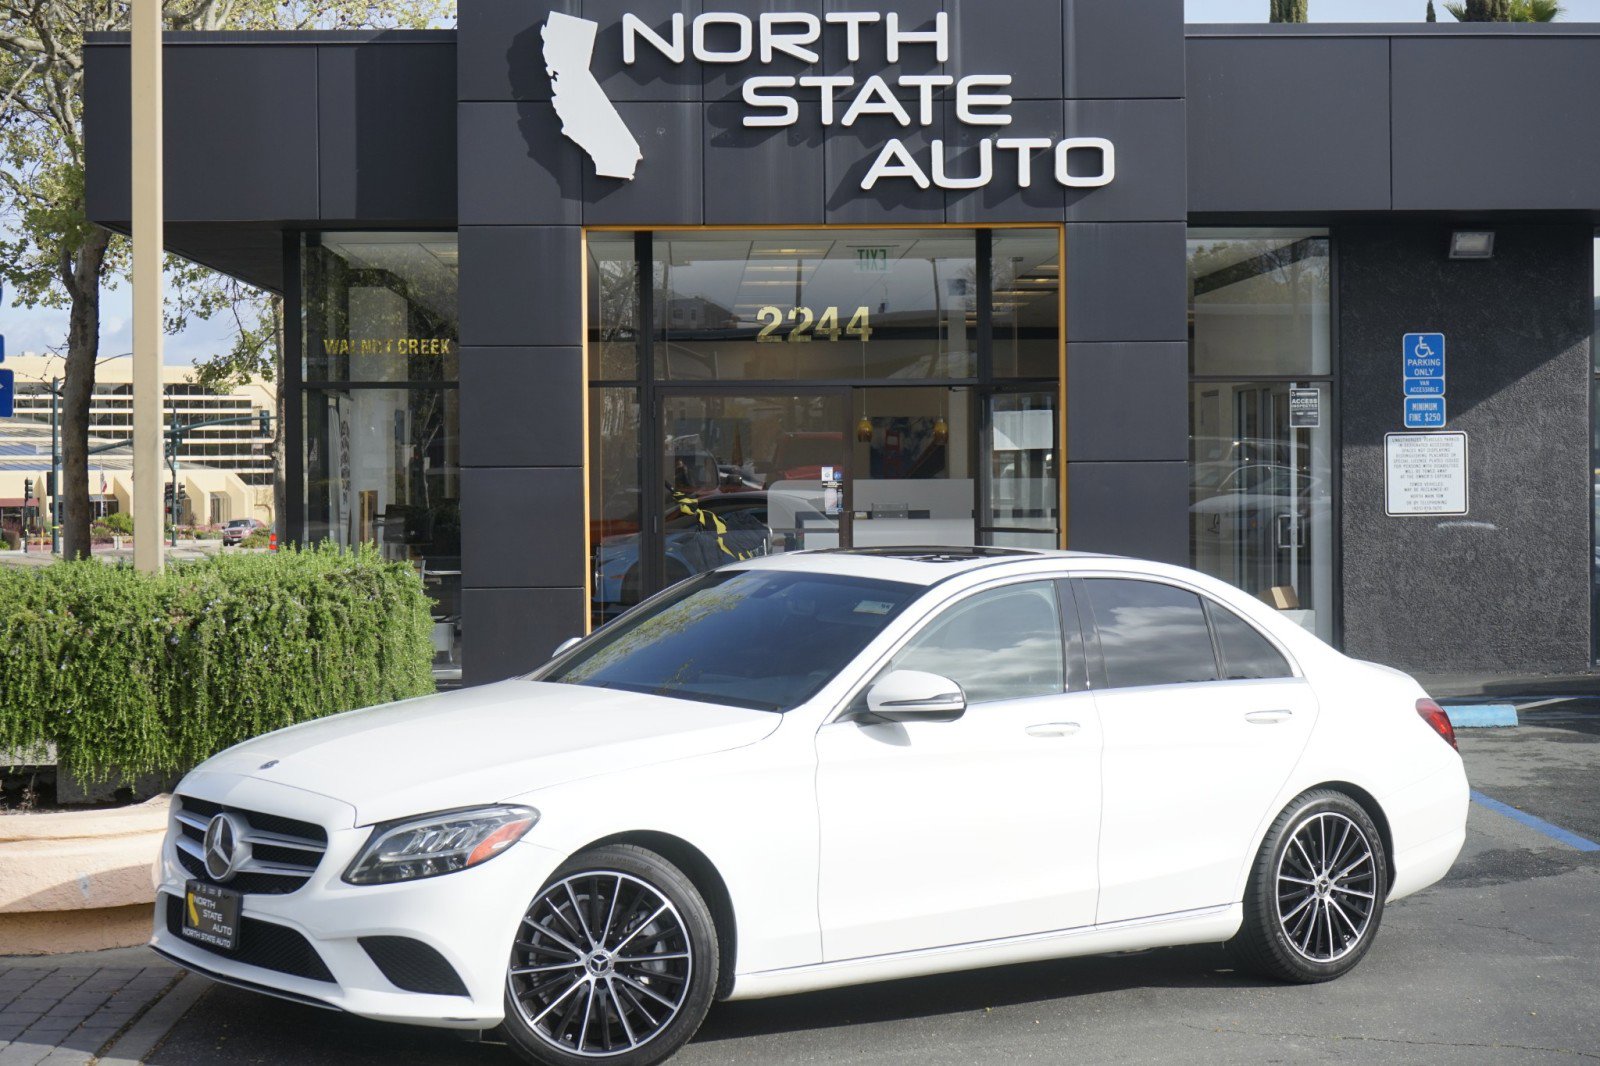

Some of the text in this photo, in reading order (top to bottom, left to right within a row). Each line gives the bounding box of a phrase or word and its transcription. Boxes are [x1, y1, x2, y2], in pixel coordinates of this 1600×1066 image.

[622, 12, 949, 64] NORTH
[742, 75, 1013, 128] STATE
[860, 137, 1116, 190] AUTO
[756, 306, 873, 343] 2244
[397, 339, 450, 355] CREEK
[1414, 368, 1434, 376] ONLY
[1412, 402, 1438, 411] MINIMUM
[1408, 413, 1441, 422] FINE $250
[193, 895, 216, 909] NORTH
[202, 909, 223, 922] STATE
[212, 923, 233, 936] AUTO
[182, 927, 231, 948] NORTH STATE AUTO
